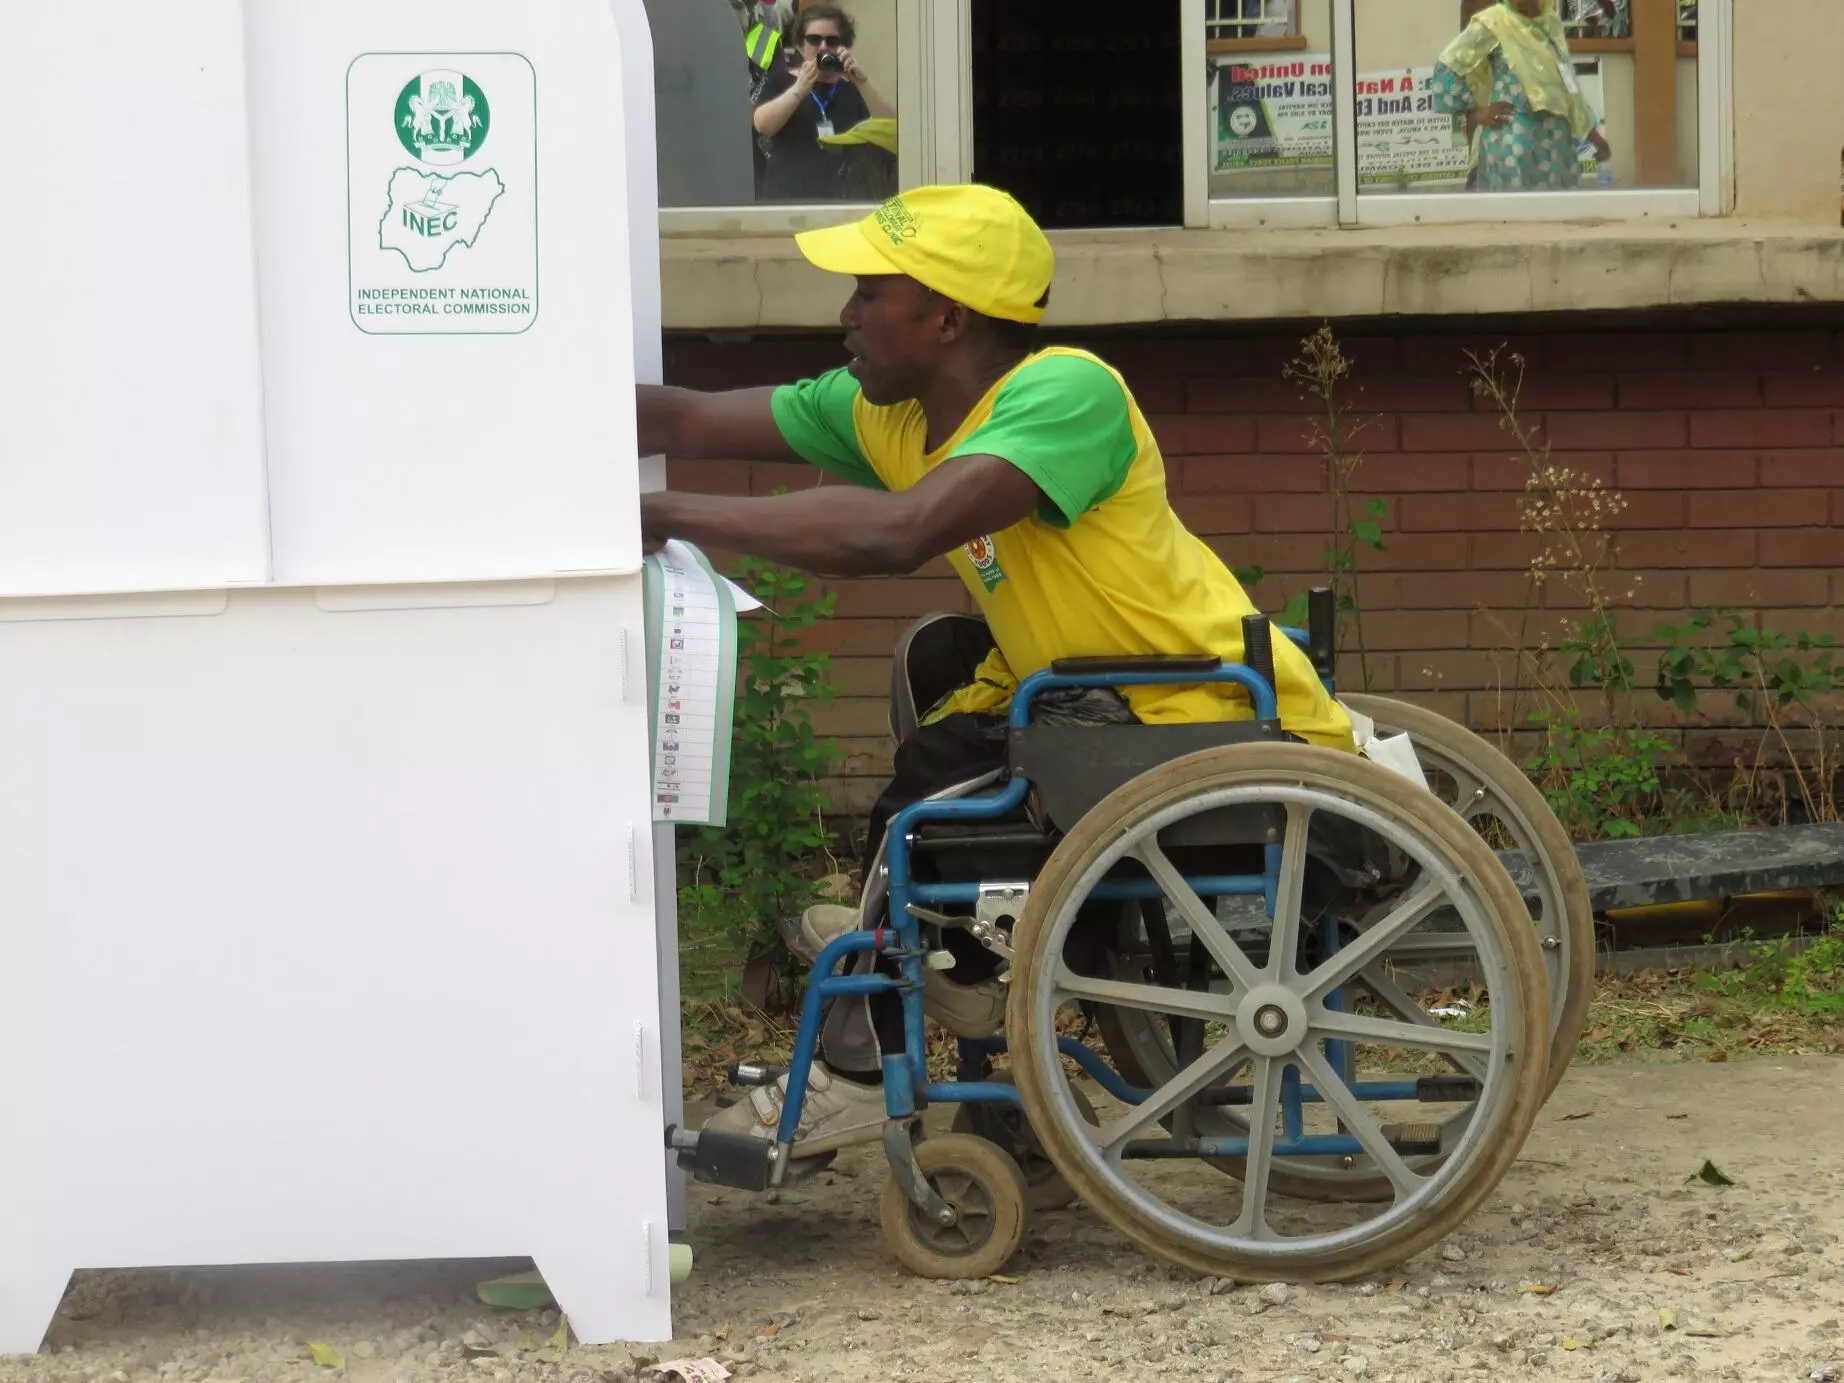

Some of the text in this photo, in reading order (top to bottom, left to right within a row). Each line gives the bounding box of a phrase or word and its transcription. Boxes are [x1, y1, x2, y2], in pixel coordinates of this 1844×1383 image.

[403, 208, 457, 237] INEC
[357, 288, 530, 300] INDEPENDENT NATIONAL
[358, 303, 530, 315] ELECTORAL COMMISSION
